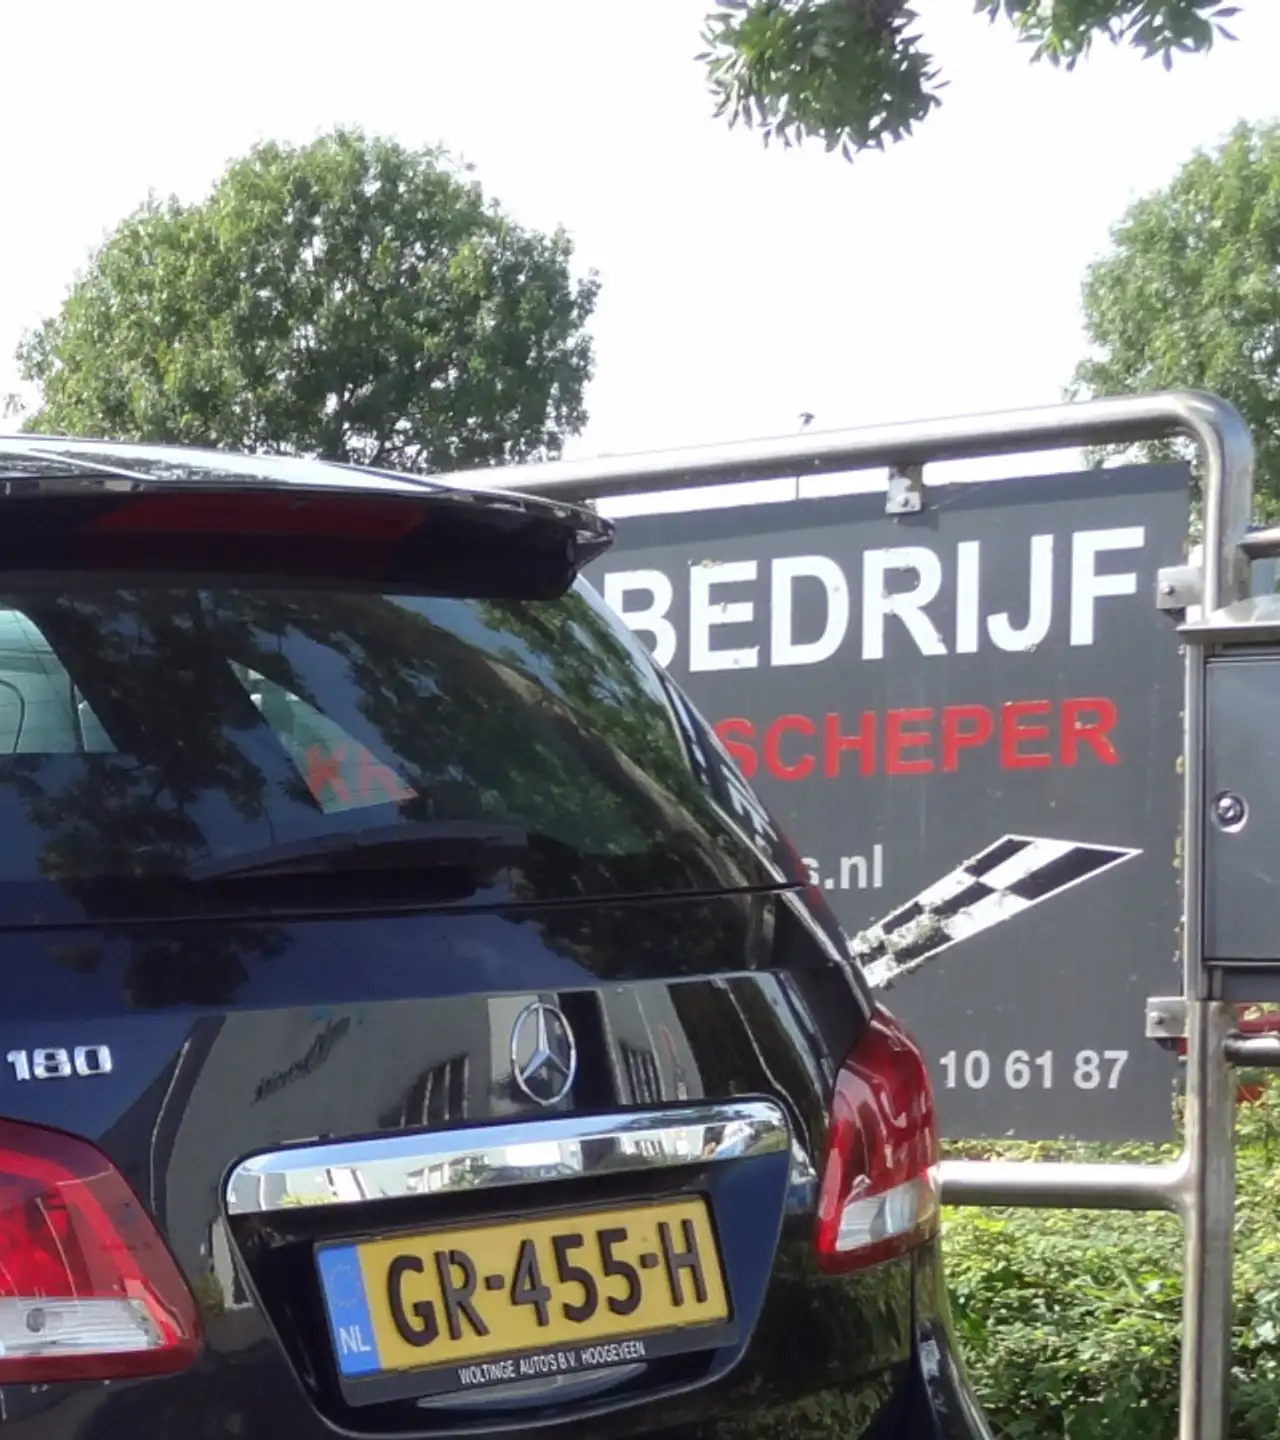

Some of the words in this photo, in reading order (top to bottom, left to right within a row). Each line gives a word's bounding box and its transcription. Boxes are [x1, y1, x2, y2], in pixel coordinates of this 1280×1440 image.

[604, 526, 1146, 675] BEDRIJF
[715, 697, 1121, 782] SCHEPER
[6, 1044, 113, 1082] 180
[939, 1049, 990, 1090] 10
[1004, 1049, 1054, 1090] 61
[1073, 1049, 1129, 1090] 87
[386, 1217, 708, 1348] GR-455-H
[339, 1325, 372, 1357] NL
[458, 1359, 517, 1385] WOLTINGE
[580, 1340, 646, 1365] HOOGEVEEN
